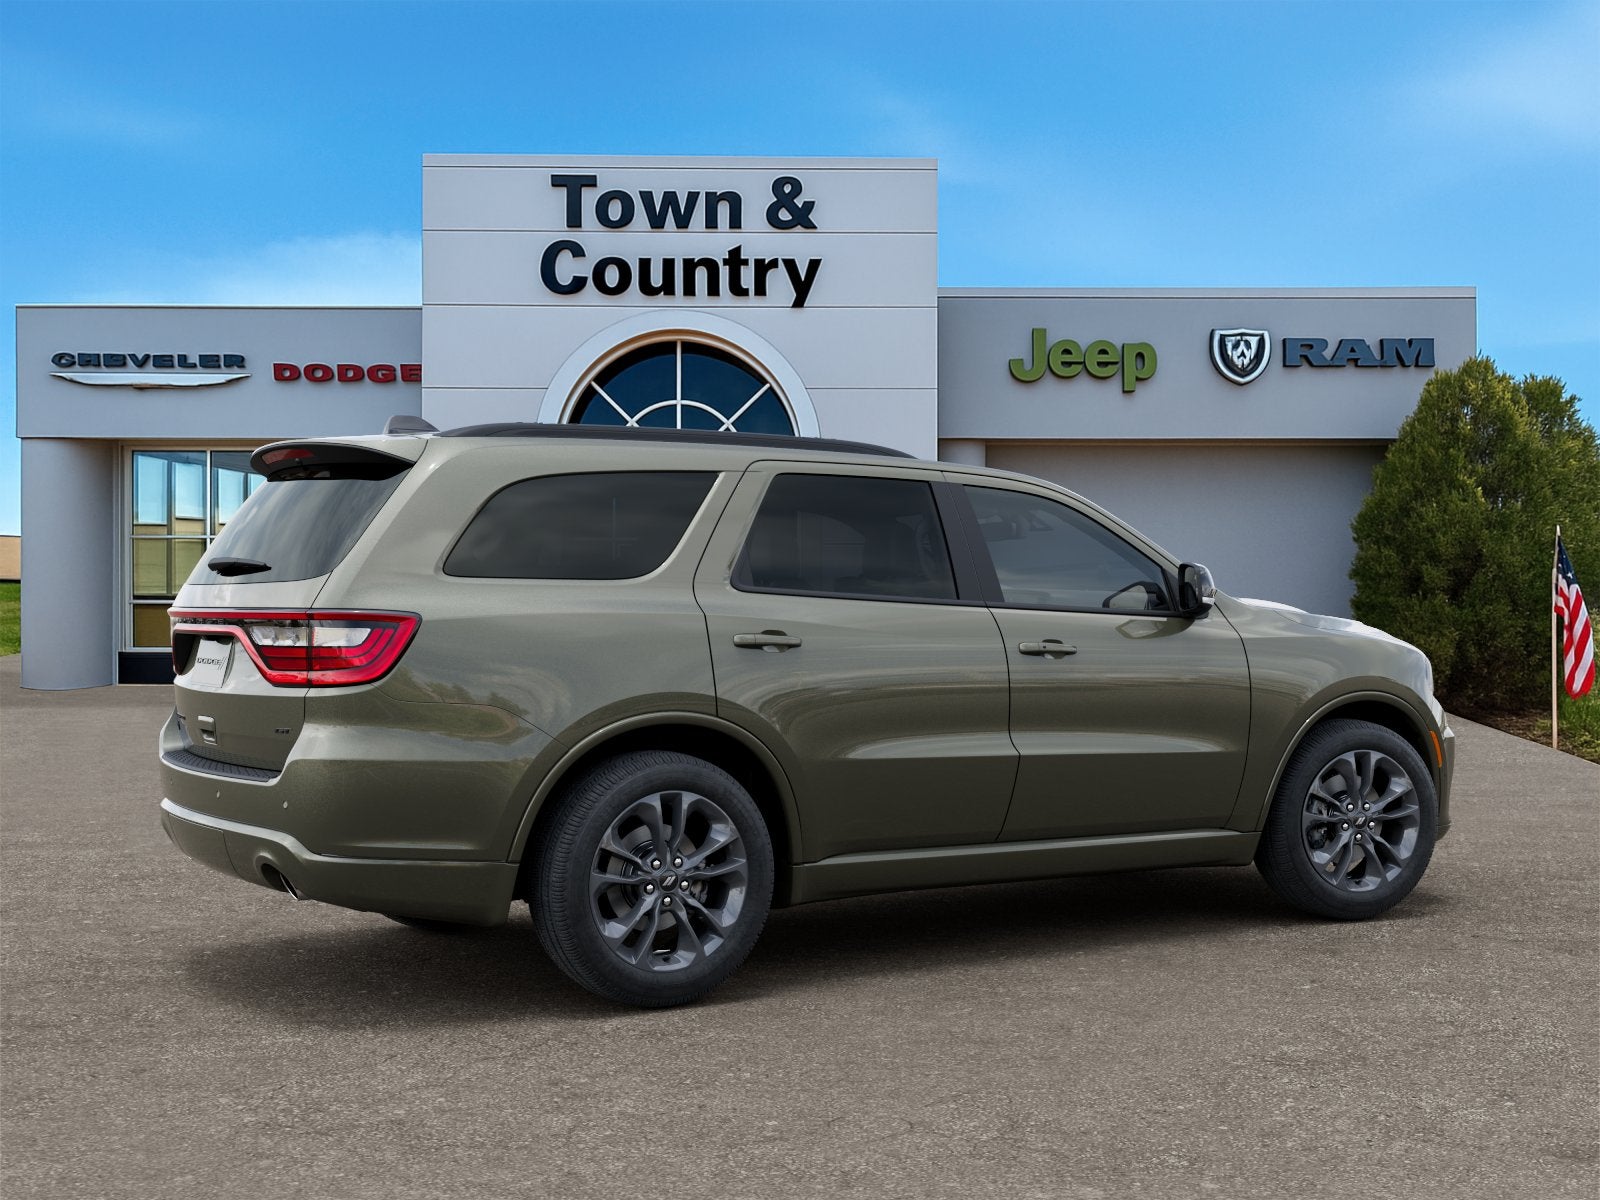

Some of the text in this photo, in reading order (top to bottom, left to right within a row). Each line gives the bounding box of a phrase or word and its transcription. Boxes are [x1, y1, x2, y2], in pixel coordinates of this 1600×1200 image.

[550, 174, 818, 229] Town &
[540, 239, 822, 308] Country
[273, 363, 422, 383] DODGE
[1009, 328, 1158, 392] Jeep
[1282, 337, 1435, 367] RAM
